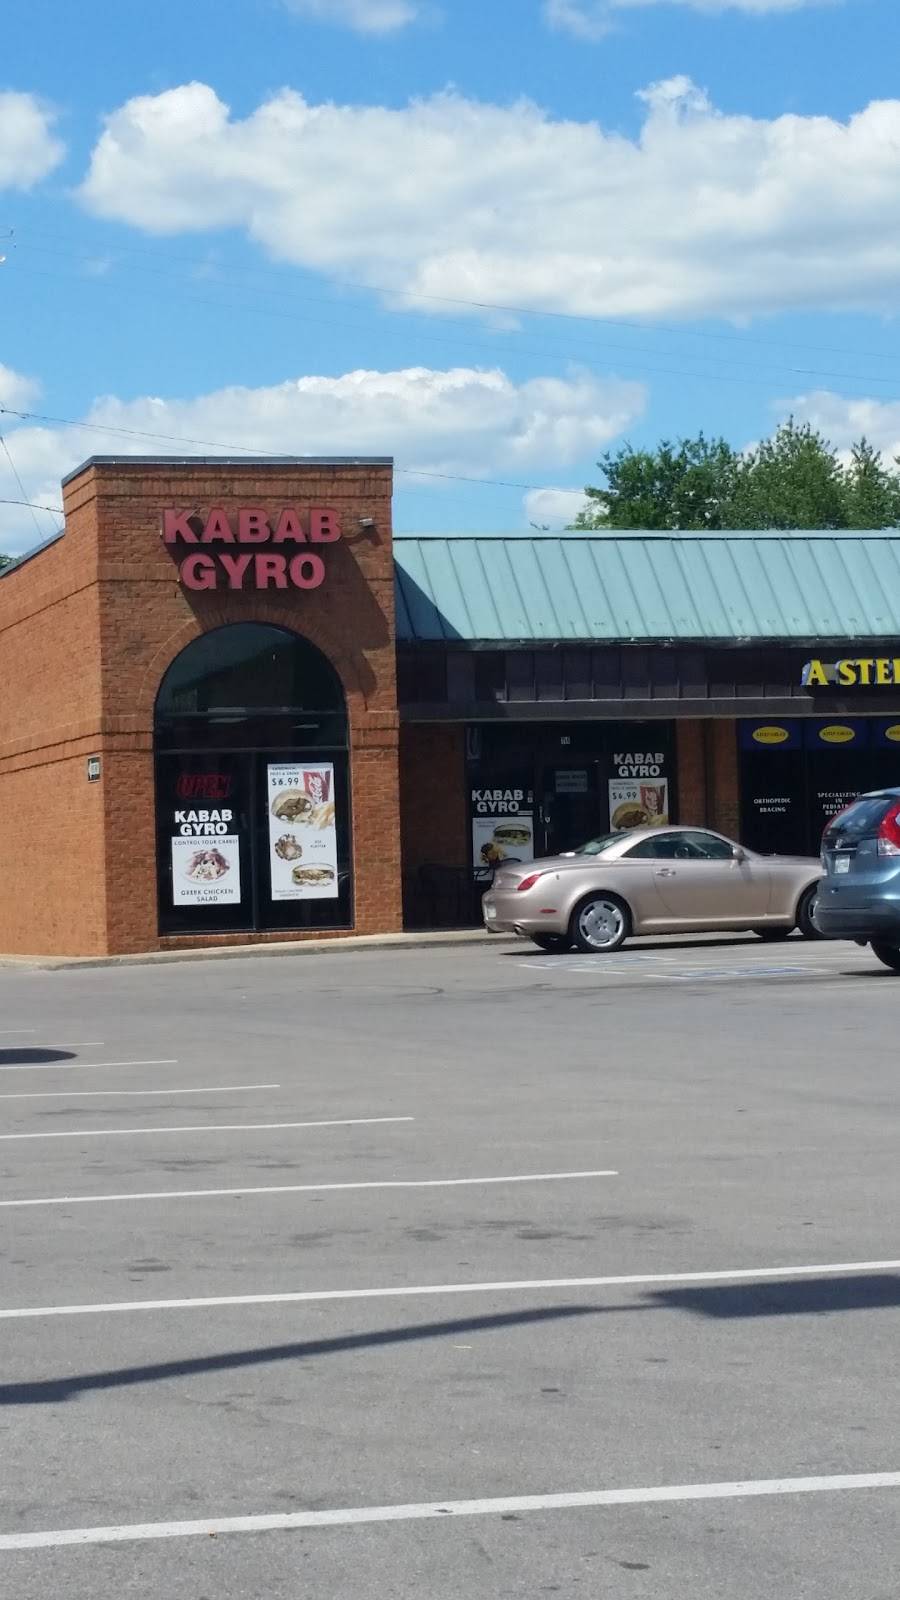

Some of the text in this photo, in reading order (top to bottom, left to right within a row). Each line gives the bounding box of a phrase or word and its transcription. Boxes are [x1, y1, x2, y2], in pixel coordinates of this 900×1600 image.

[163, 507, 342, 545] KABAB
[180, 552, 326, 591] GYRO
[803, 659, 830, 686] A
[613, 753, 665, 765] KABAB
[618, 765, 660, 777] GYRO
[271, 777, 299, 786] $6.99
[471, 789, 524, 801] KABAB
[612, 791, 638, 800] $6.99
[476, 801, 519, 813] GYRO
[174, 808, 233, 823] KABAB
[180, 822, 228, 836] GYRO
